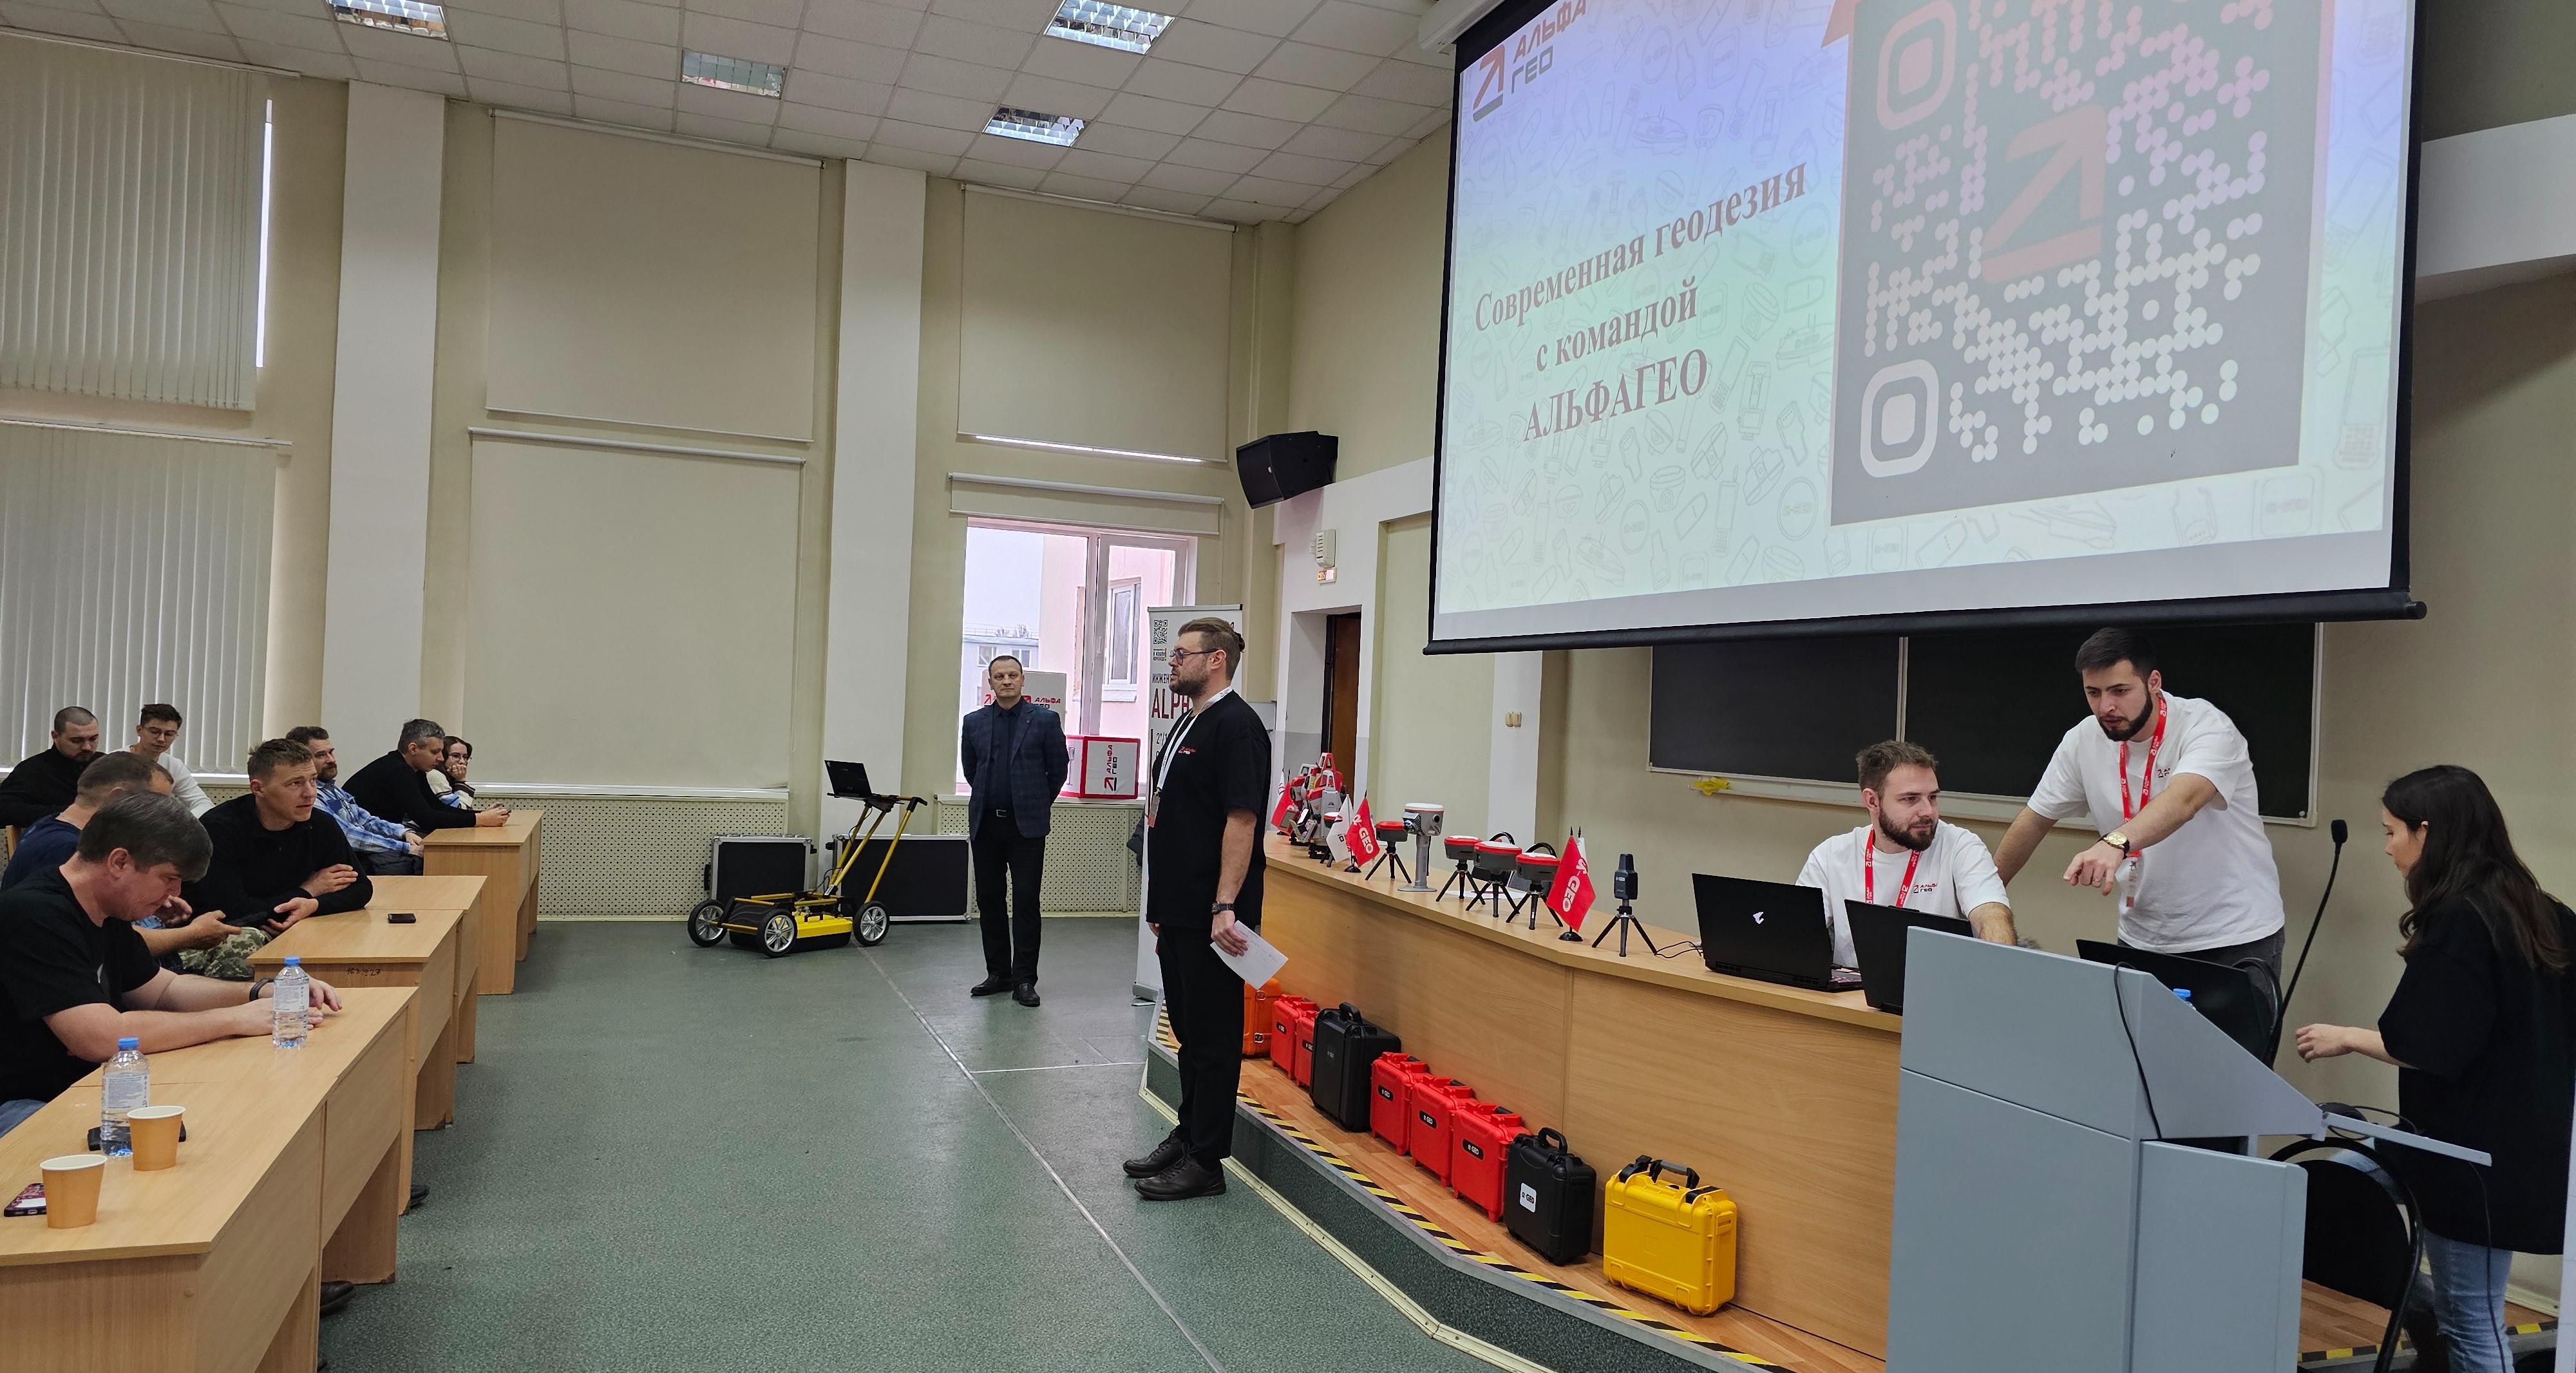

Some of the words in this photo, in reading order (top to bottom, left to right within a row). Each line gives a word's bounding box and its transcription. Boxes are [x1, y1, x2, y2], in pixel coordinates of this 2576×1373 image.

[1511, 45, 1553, 94] ГЕО
[1513, 0, 1586, 64] АЛЬФА
[1475, 234, 1645, 332] Современная
[1654, 162, 1807, 258] геодезия
[1537, 343, 1548, 372] с
[1555, 276, 1698, 366] командой
[1523, 348, 1707, 442] АЛЬФАГЕО
